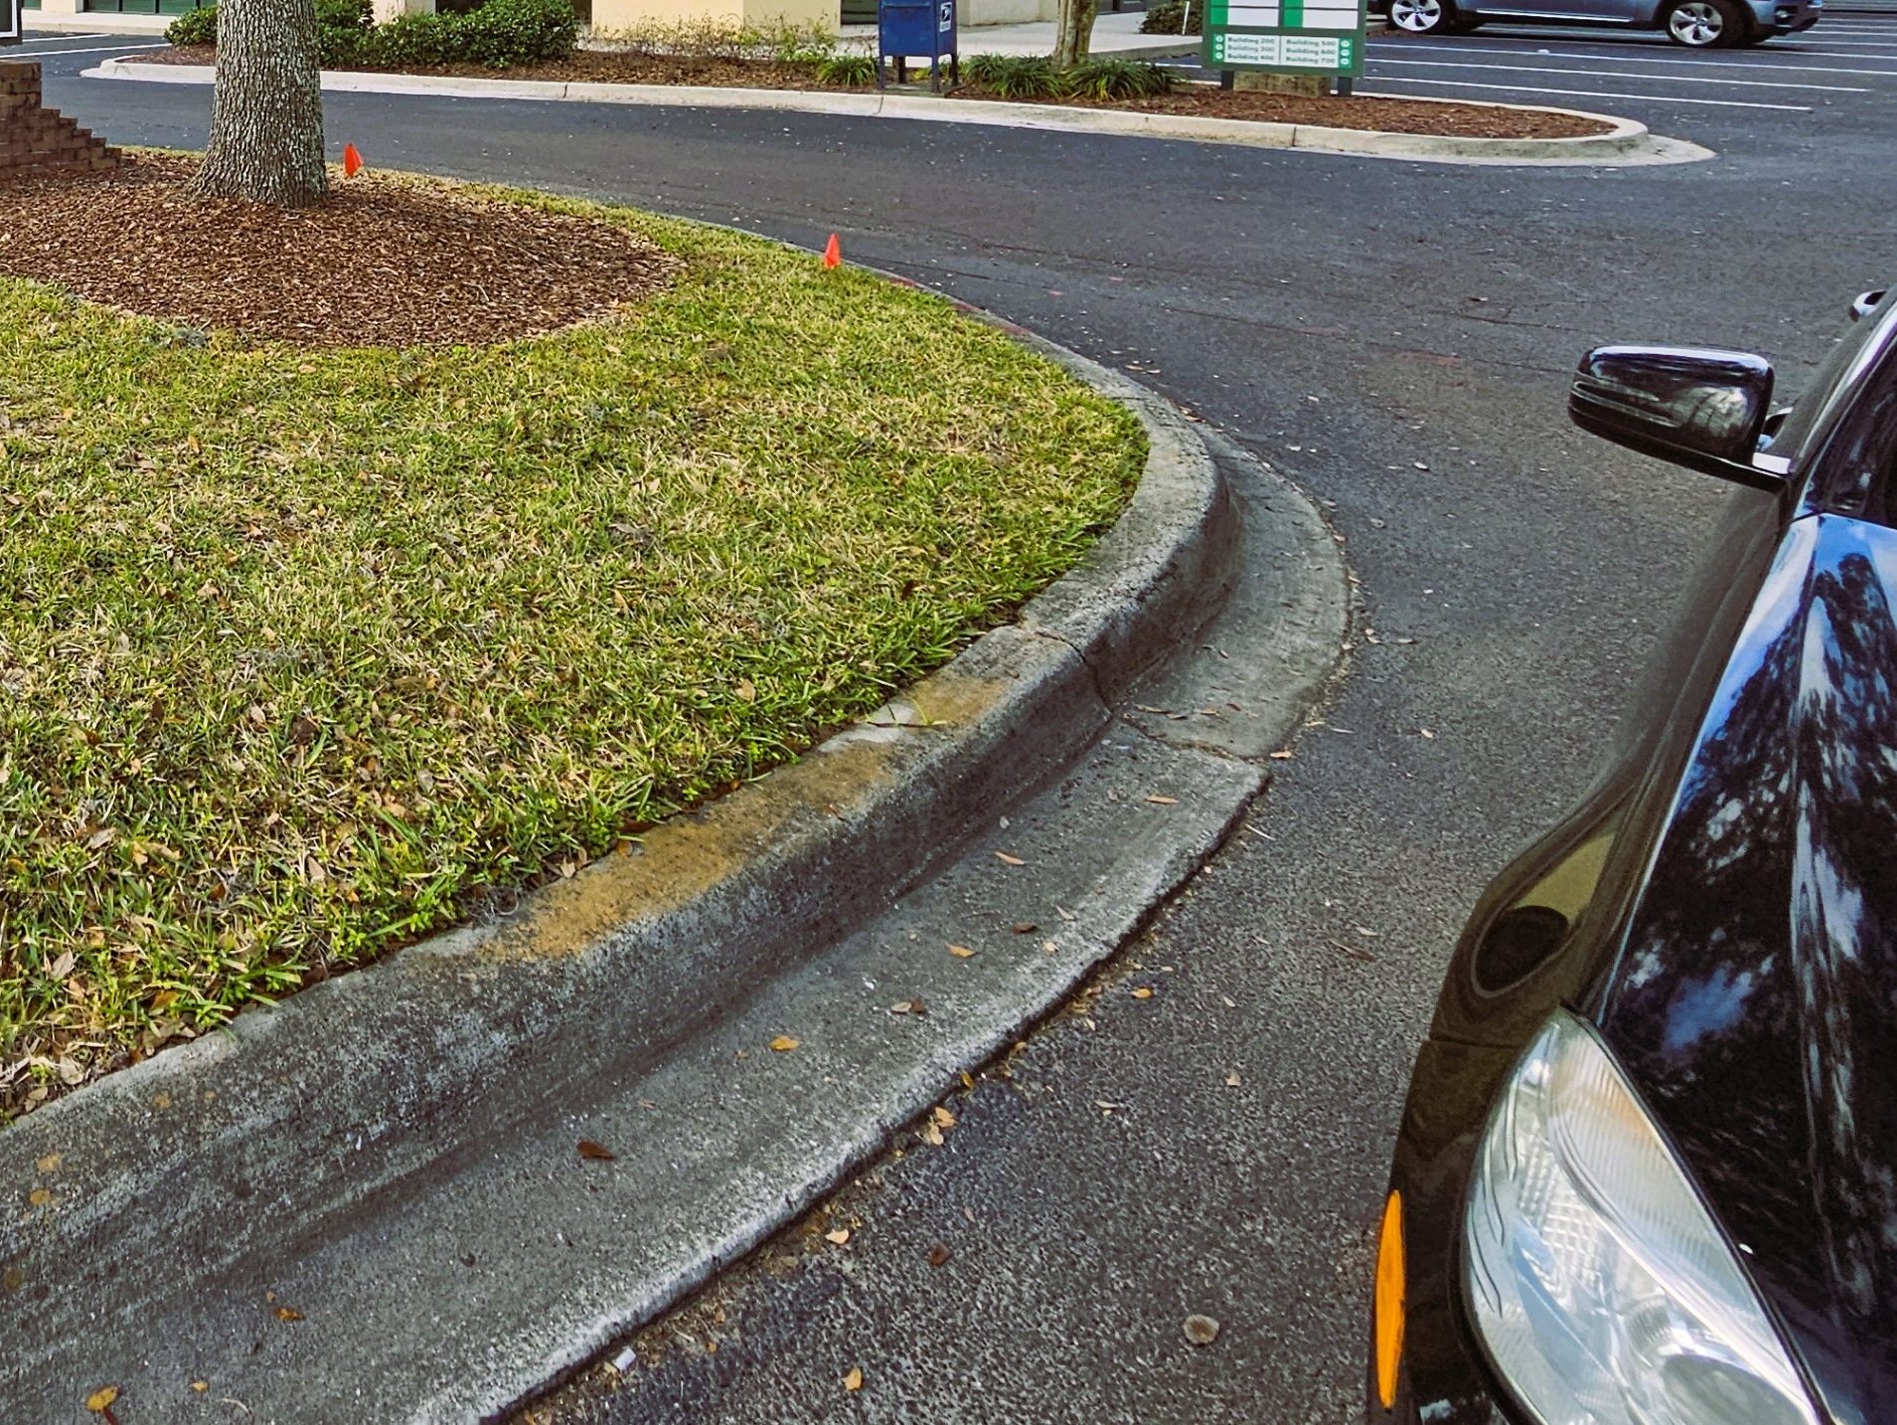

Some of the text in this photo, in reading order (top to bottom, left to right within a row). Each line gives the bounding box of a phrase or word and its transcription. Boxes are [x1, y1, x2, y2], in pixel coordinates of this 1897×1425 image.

[1228, 37, 1259, 45] Building
[1286, 39, 1319, 47] Building
[1228, 45, 1259, 53] Building
[1286, 47, 1319, 55] Building
[1228, 53, 1259, 61] Building
[1286, 56, 1319, 64] Building
